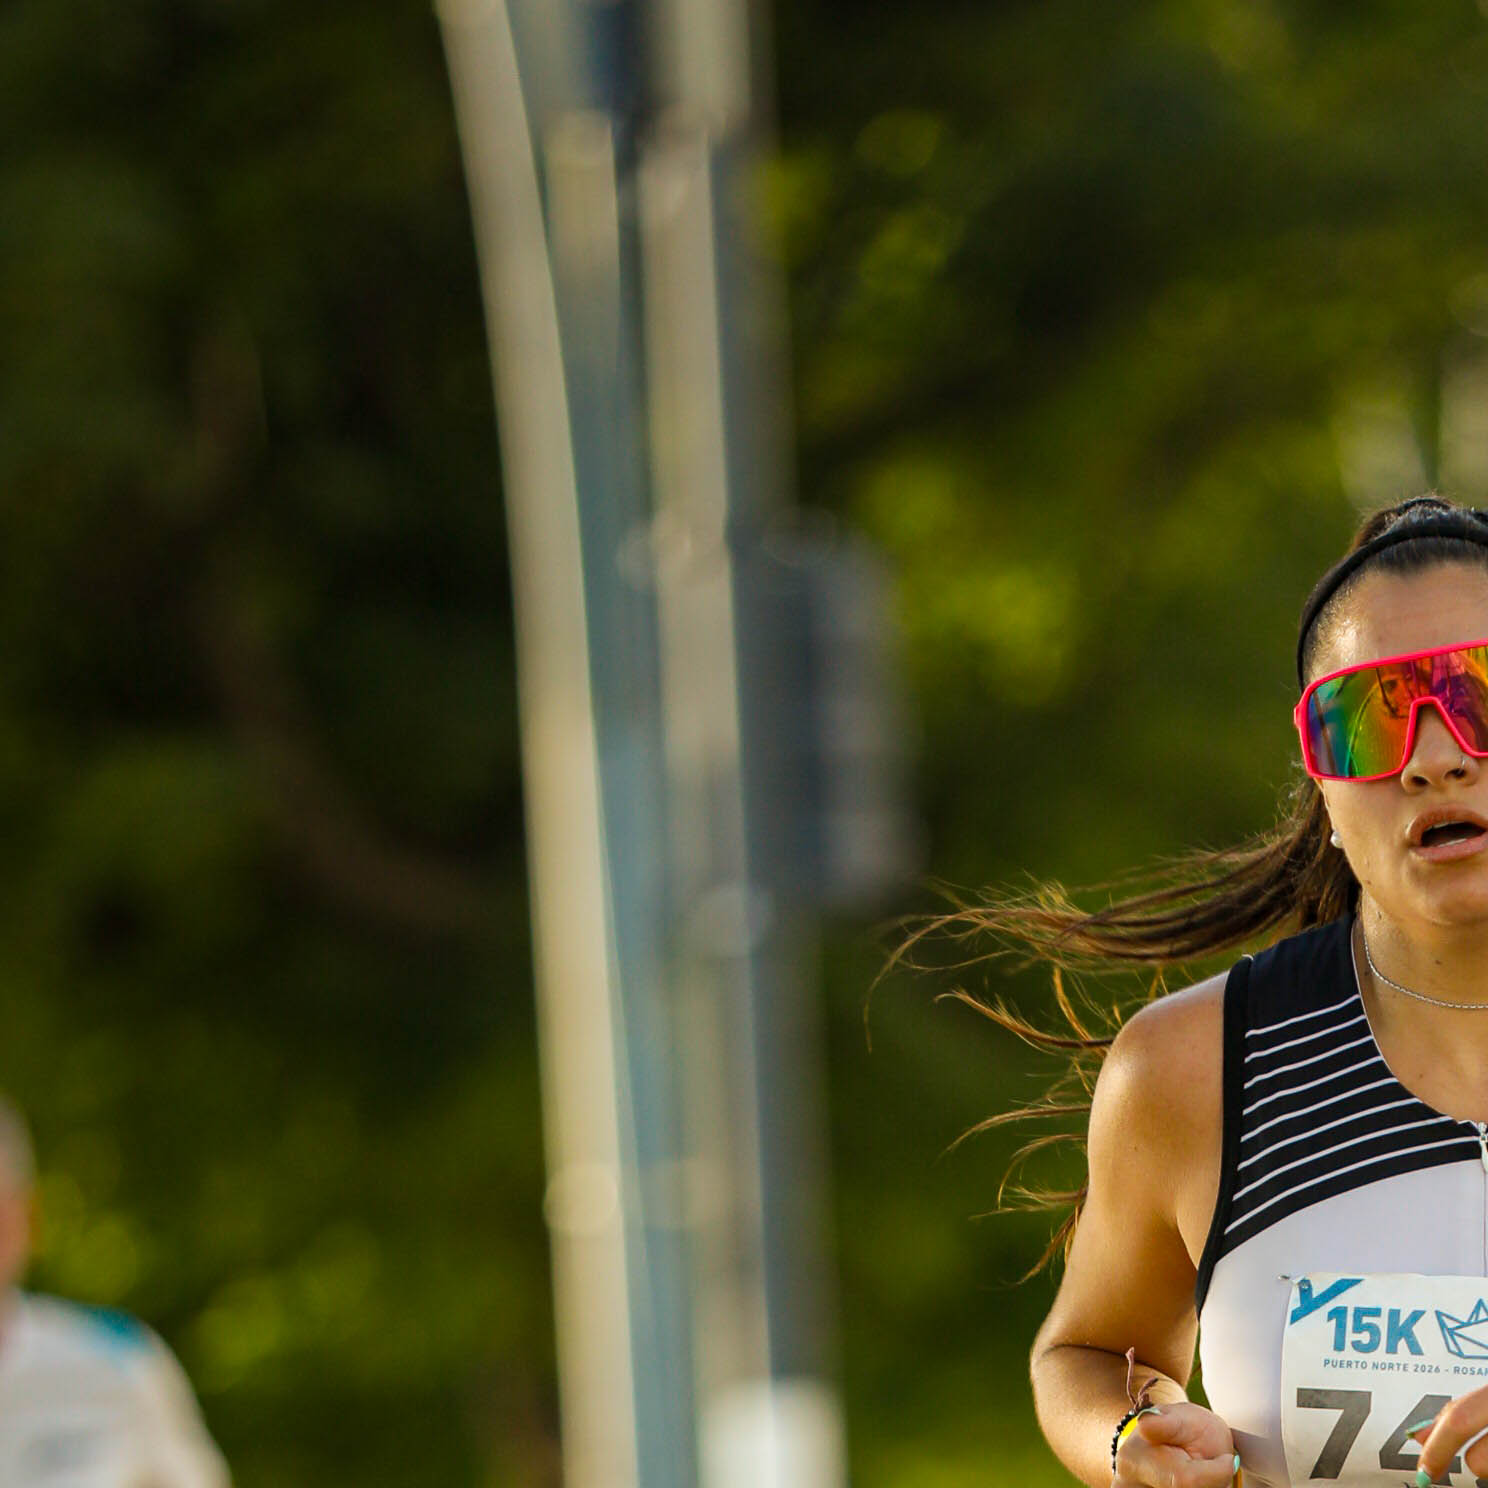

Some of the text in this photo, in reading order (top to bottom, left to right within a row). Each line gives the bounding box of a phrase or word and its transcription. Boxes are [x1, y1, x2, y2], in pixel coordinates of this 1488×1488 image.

[1326, 1305, 1428, 1357] 15K
[1323, 1357, 1369, 1370] PUERTO
[1371, 1361, 1409, 1373] NORTE
